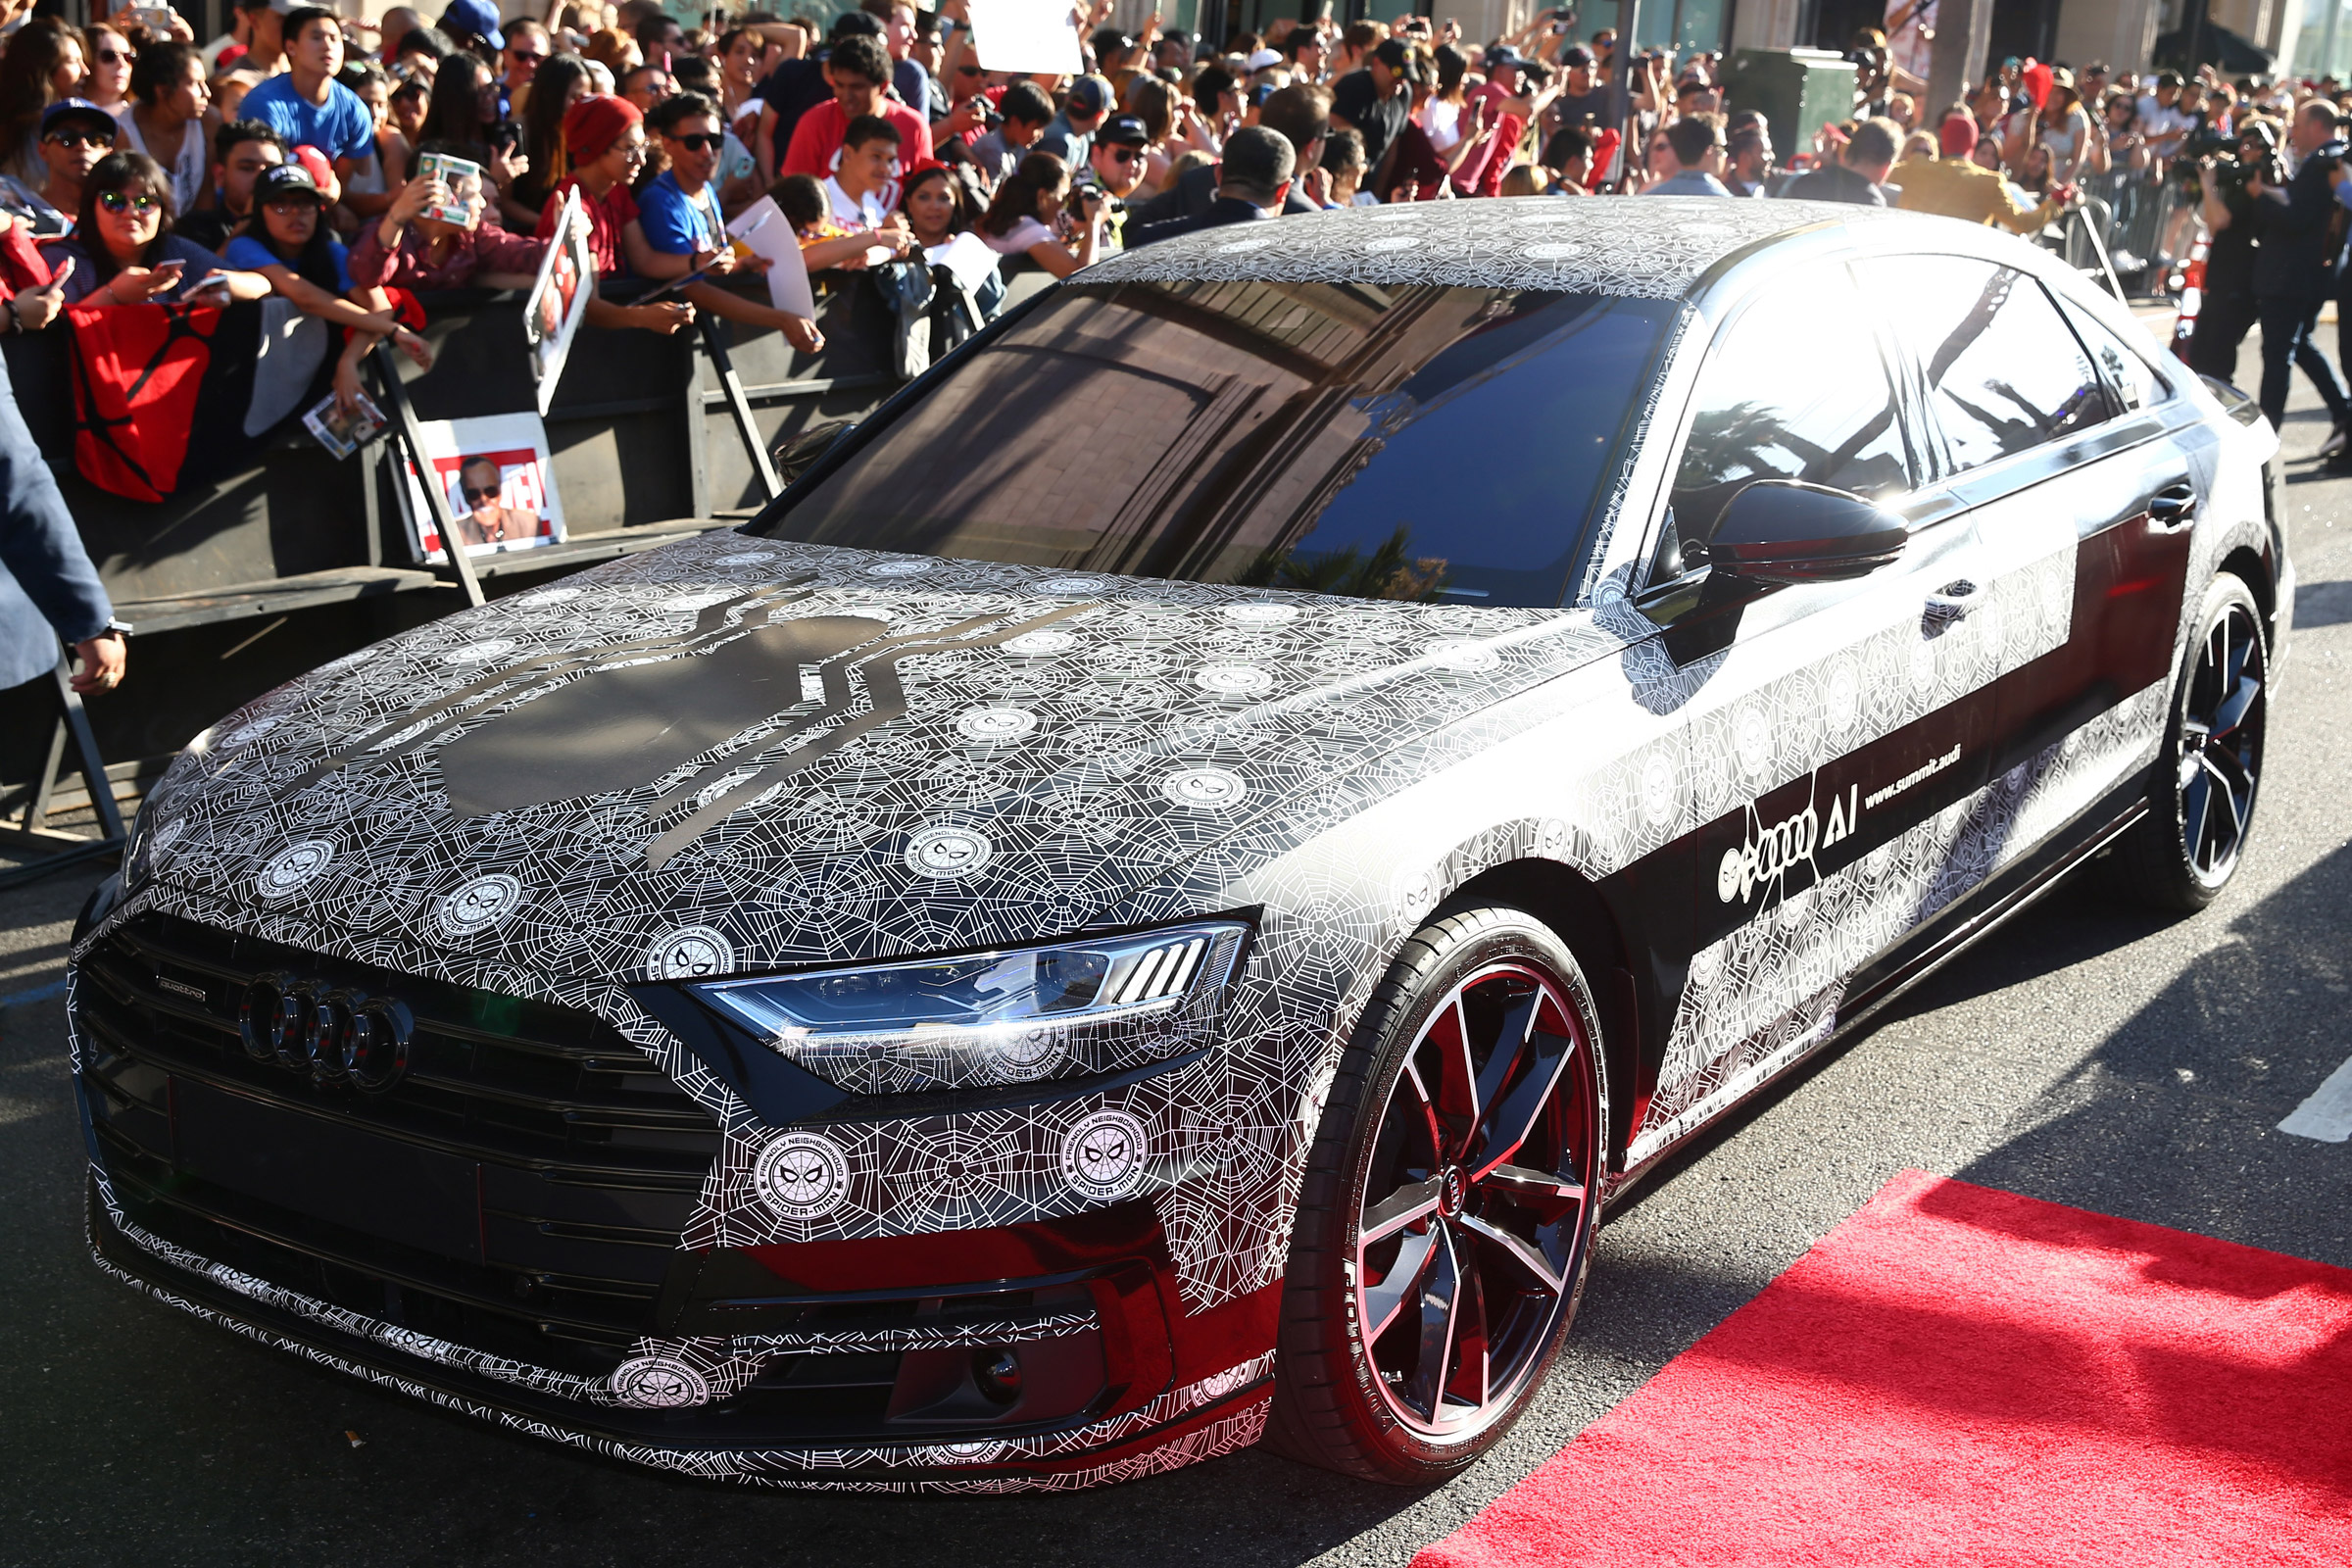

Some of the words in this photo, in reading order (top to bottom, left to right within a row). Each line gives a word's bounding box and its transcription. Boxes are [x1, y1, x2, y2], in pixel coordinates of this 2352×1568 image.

[1822, 783, 1858, 850] AI
[1865, 743, 1962, 810] www.summit.audi
[918, 830, 958, 843] FRIENDLY
[908, 853, 964, 876] SPIDER-MAN
[263, 874, 303, 895] SPIDER-MAN
[454, 877, 491, 899] FRIENDLY
[443, 908, 493, 933] SPIDER-MAN
[659, 929, 698, 951] FRIENDLY
[160, 980, 203, 999] quattro
[990, 1051, 1061, 1077] SPIDER-MAN
[1065, 1121, 1091, 1160] FRIENDLY
[1091, 1115, 1143, 1150] NEIGHBORHOOD
[760, 1141, 787, 1177] FRIENDLY
[788, 1137, 844, 1177] NEIGHBORHOOD
[1070, 1166, 1140, 1197] SPIDER-MAN
[763, 1192, 840, 1216] SPIDER-MAN
[617, 1362, 640, 1391] FRIENDLY
[641, 1359, 704, 1394] NEIGHBORHOOD
